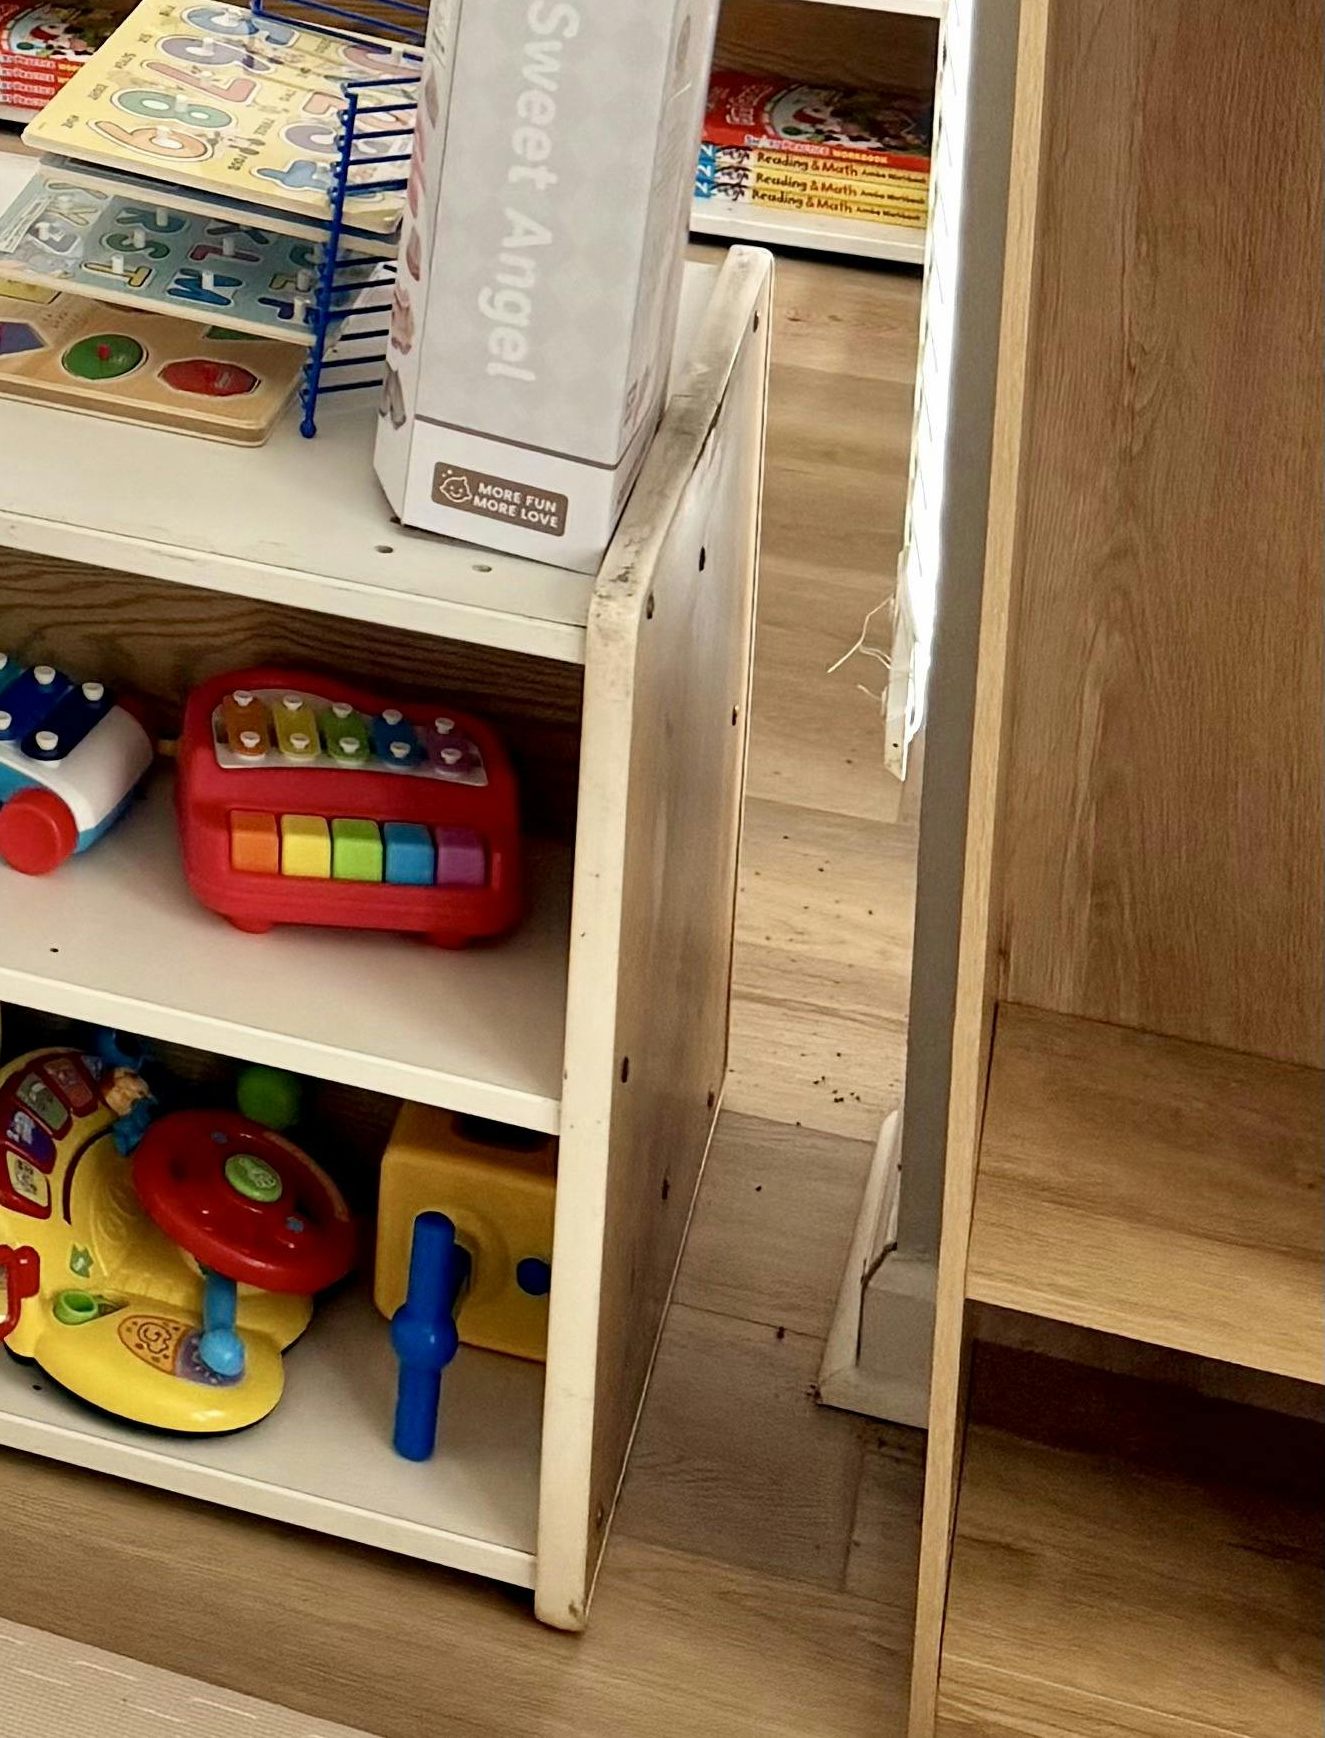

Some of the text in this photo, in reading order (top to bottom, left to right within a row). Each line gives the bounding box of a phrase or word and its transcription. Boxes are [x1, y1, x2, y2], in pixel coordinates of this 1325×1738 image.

[757, 152, 808, 171] Reading
[811, 160, 820, 170] &
[823, 162, 858, 176] Math
[832, 149, 889, 163] WORKBOOK
[756, 172, 807, 191] Reading
[810, 180, 819, 191] &
[821, 182, 856, 196] Math
[751, 190, 803, 208] Reading
[805, 197, 814, 208] &
[816, 199, 853, 213] Math
[478, 207, 554, 383] Angel
[478, 483, 557, 513] MORE FUN
[473, 496, 559, 528] MORE LOVE
